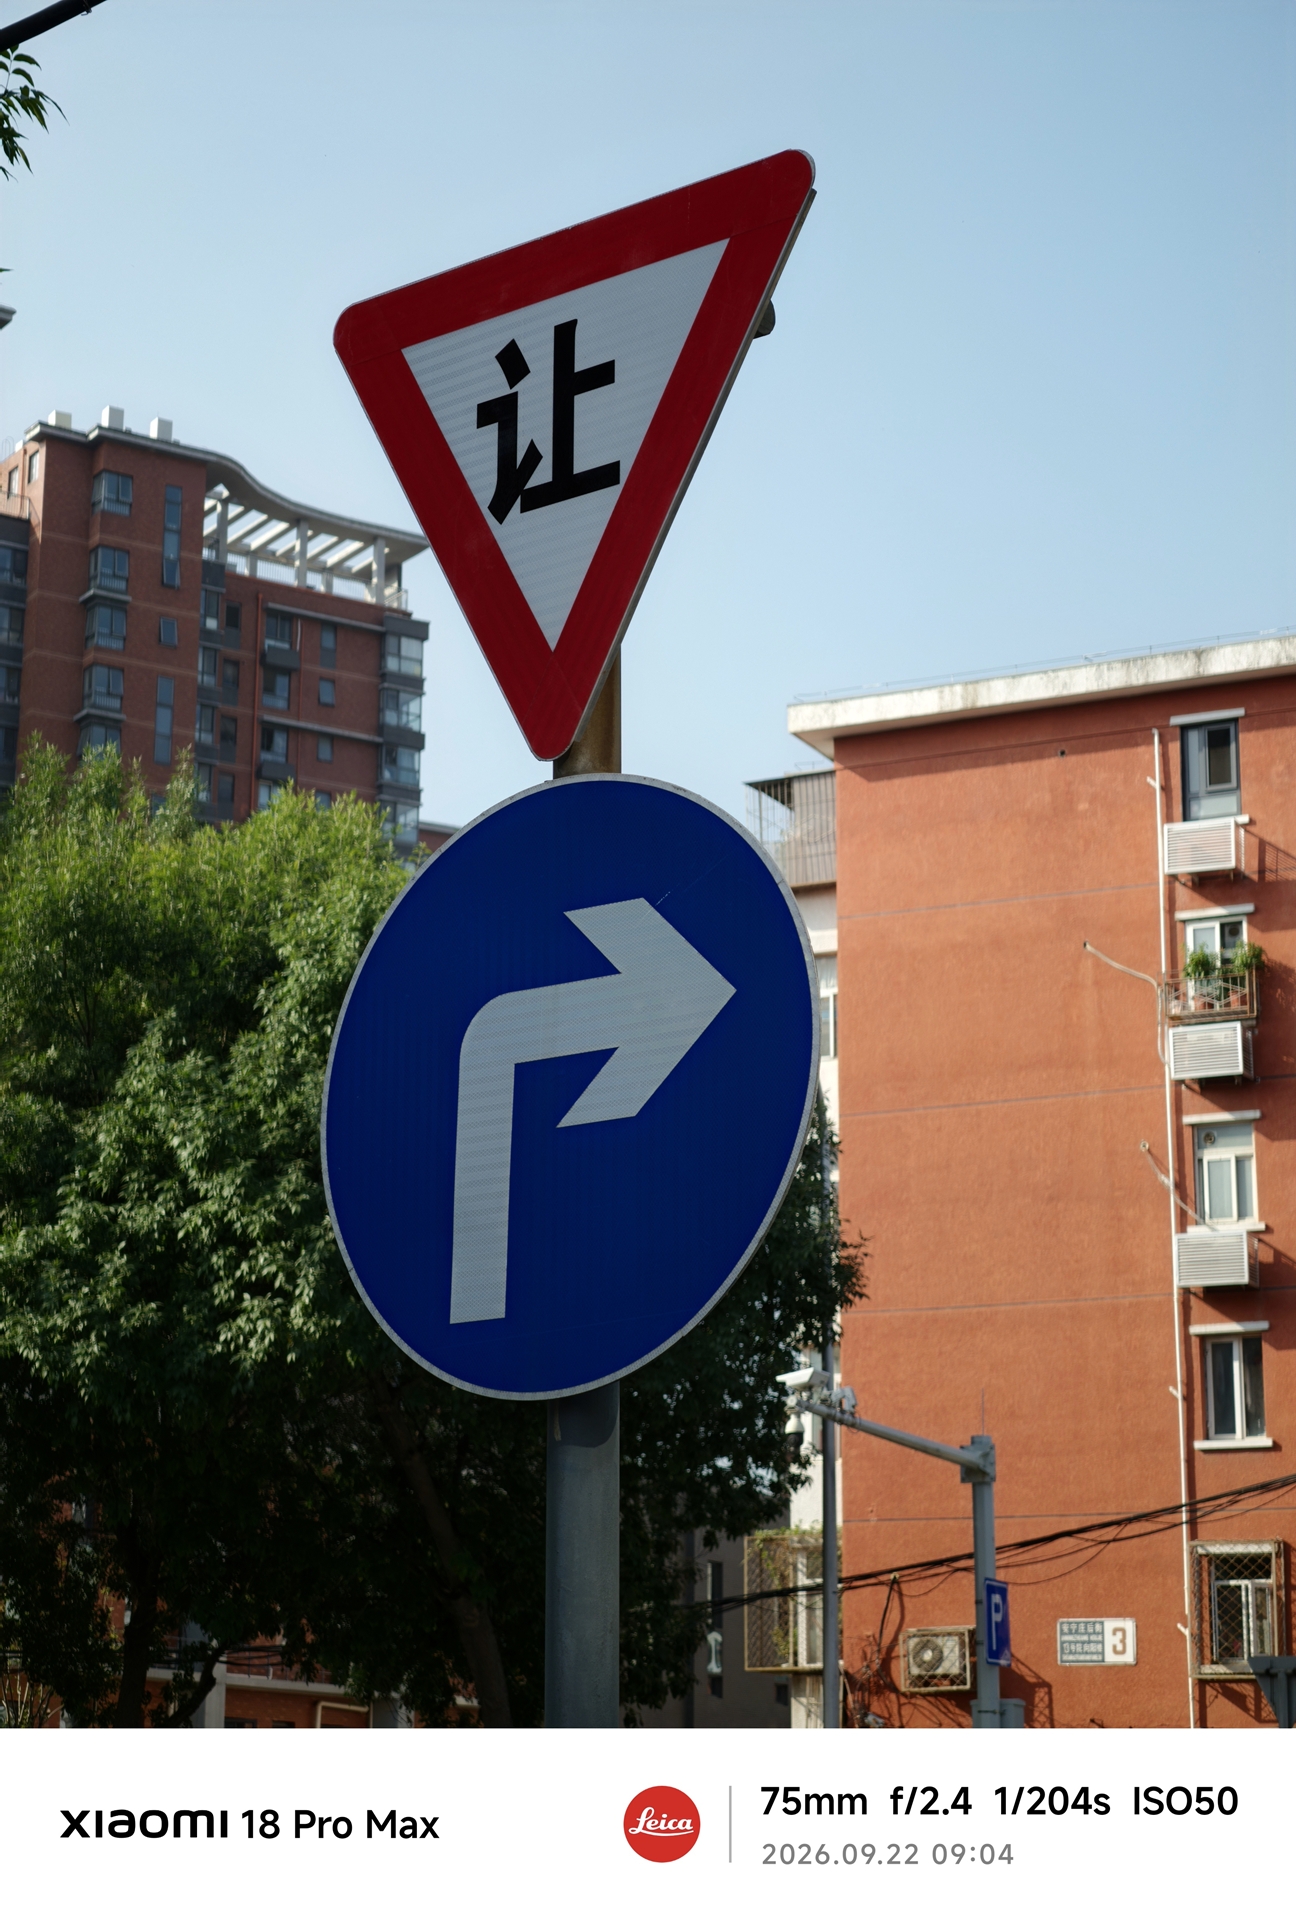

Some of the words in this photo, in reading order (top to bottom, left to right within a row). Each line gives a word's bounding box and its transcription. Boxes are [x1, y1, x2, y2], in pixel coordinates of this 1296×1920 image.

[476, 318, 621, 525] 让
[991, 1593, 1003, 1651] P
[1112, 1627, 1127, 1655] 3
